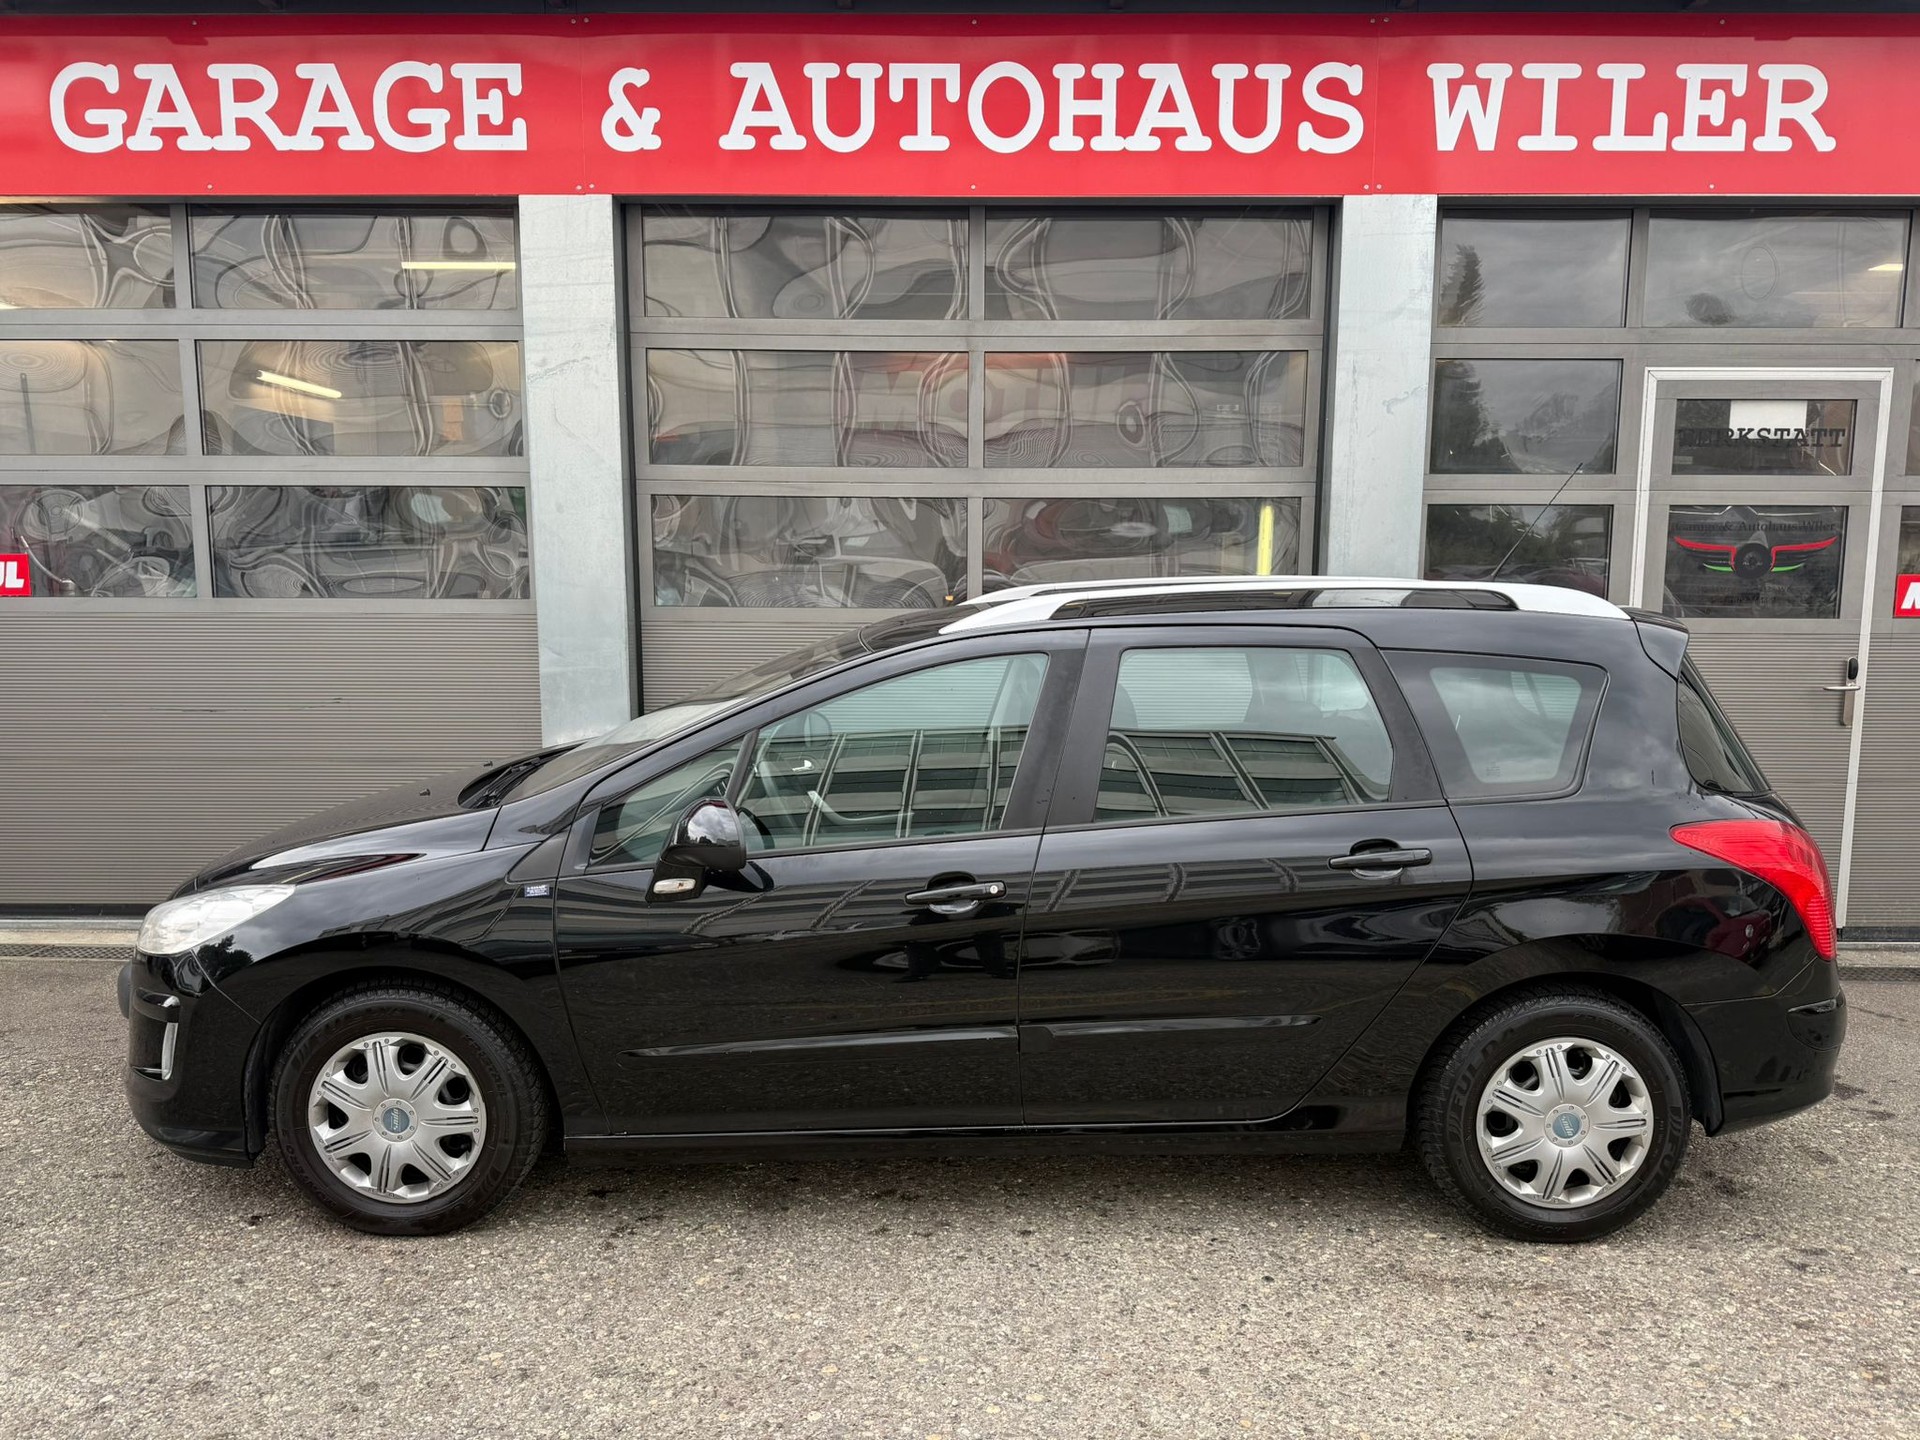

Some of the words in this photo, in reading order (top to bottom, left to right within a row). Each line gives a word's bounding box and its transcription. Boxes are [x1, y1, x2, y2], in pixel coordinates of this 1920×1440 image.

[49, 60, 528, 154] GARAGE
[600, 67, 662, 153] &
[718, 61, 1365, 154] AUTOHAUS
[1426, 62, 1837, 153] WILER
